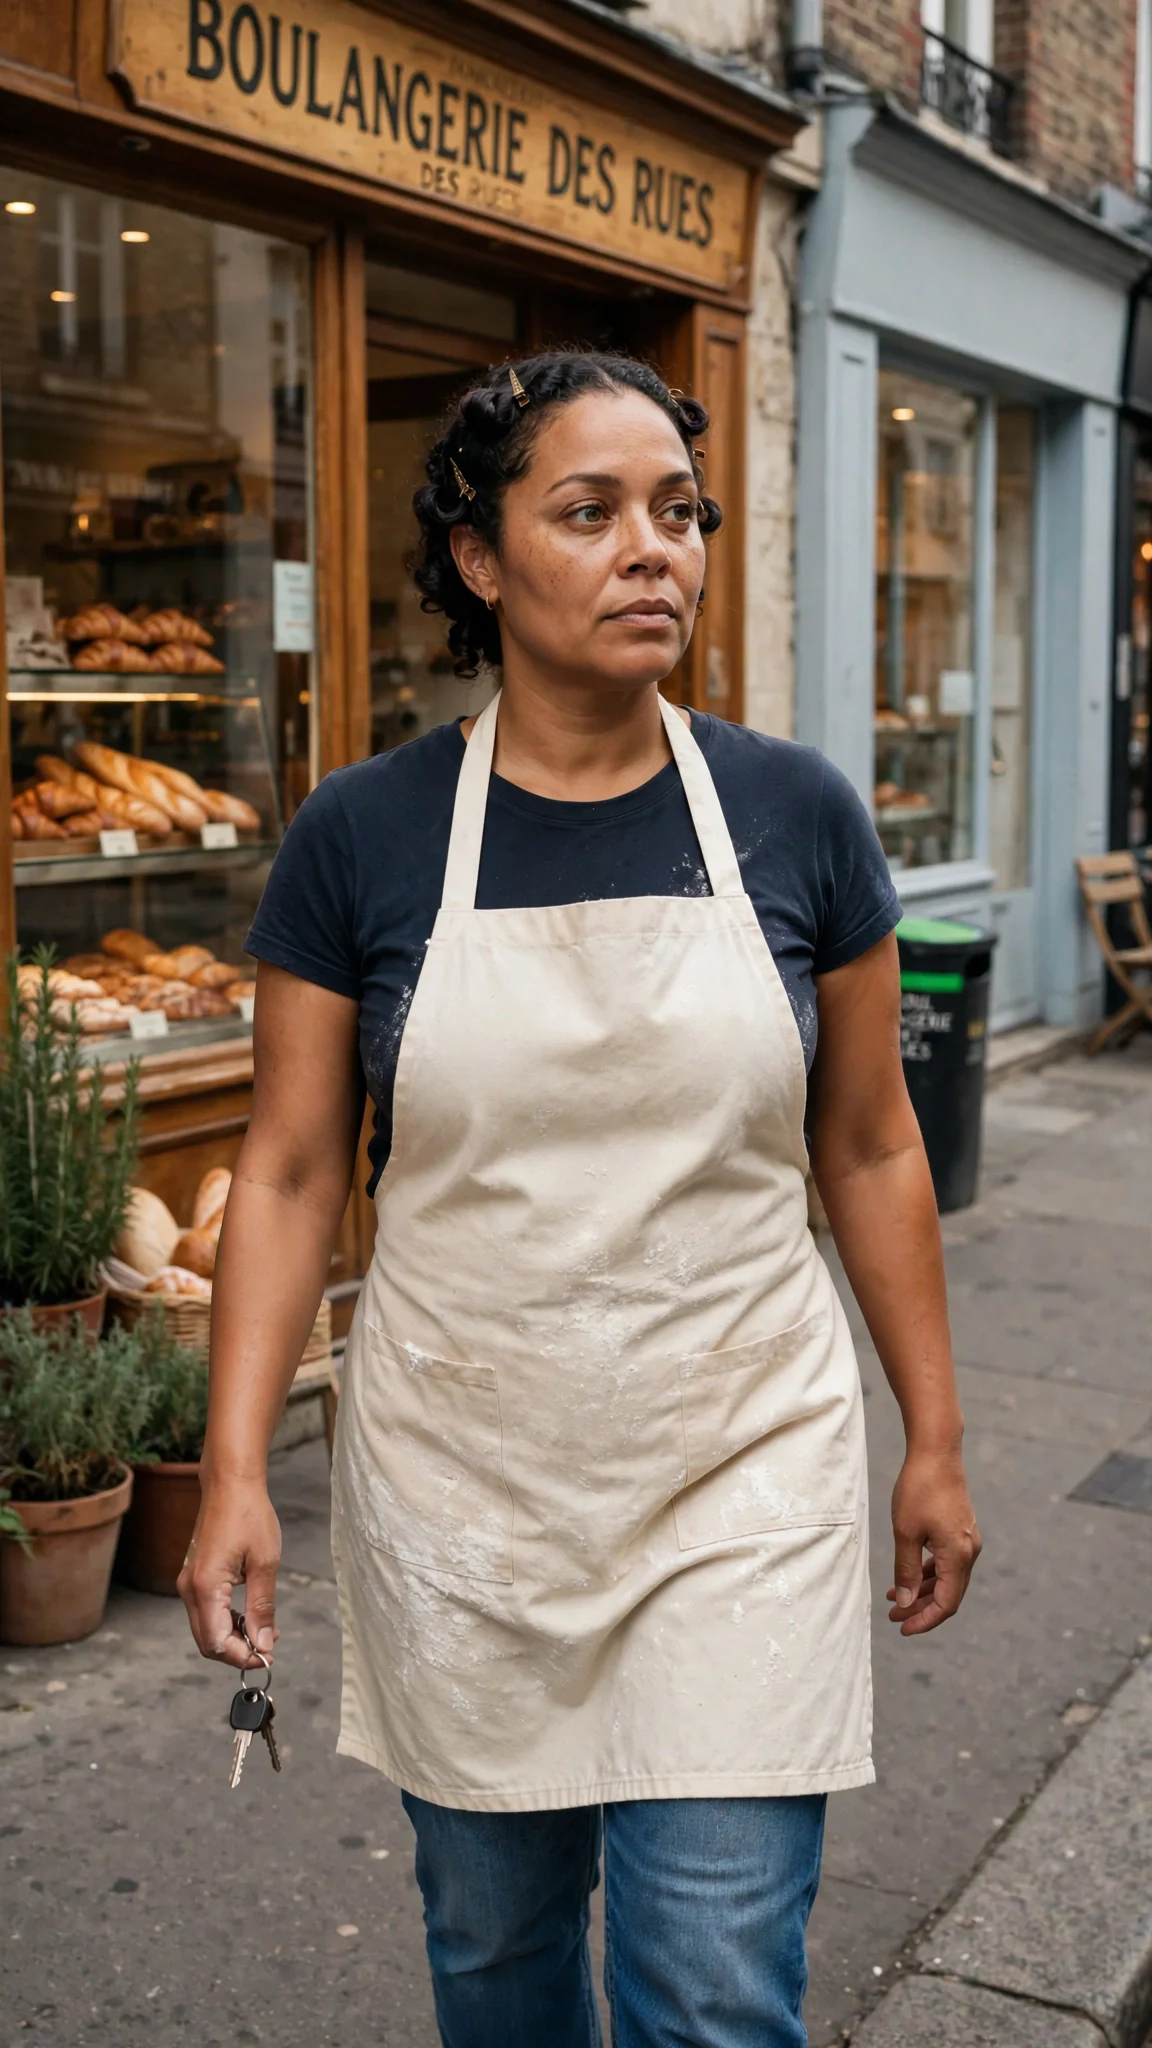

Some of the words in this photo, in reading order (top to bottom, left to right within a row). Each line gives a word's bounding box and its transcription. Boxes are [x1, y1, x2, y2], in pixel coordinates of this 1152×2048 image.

[186, 0, 528, 185] BOULANGERIE
[547, 122, 616, 216] DES
[631, 156, 715, 248] RUES
[420, 161, 461, 196] DES
